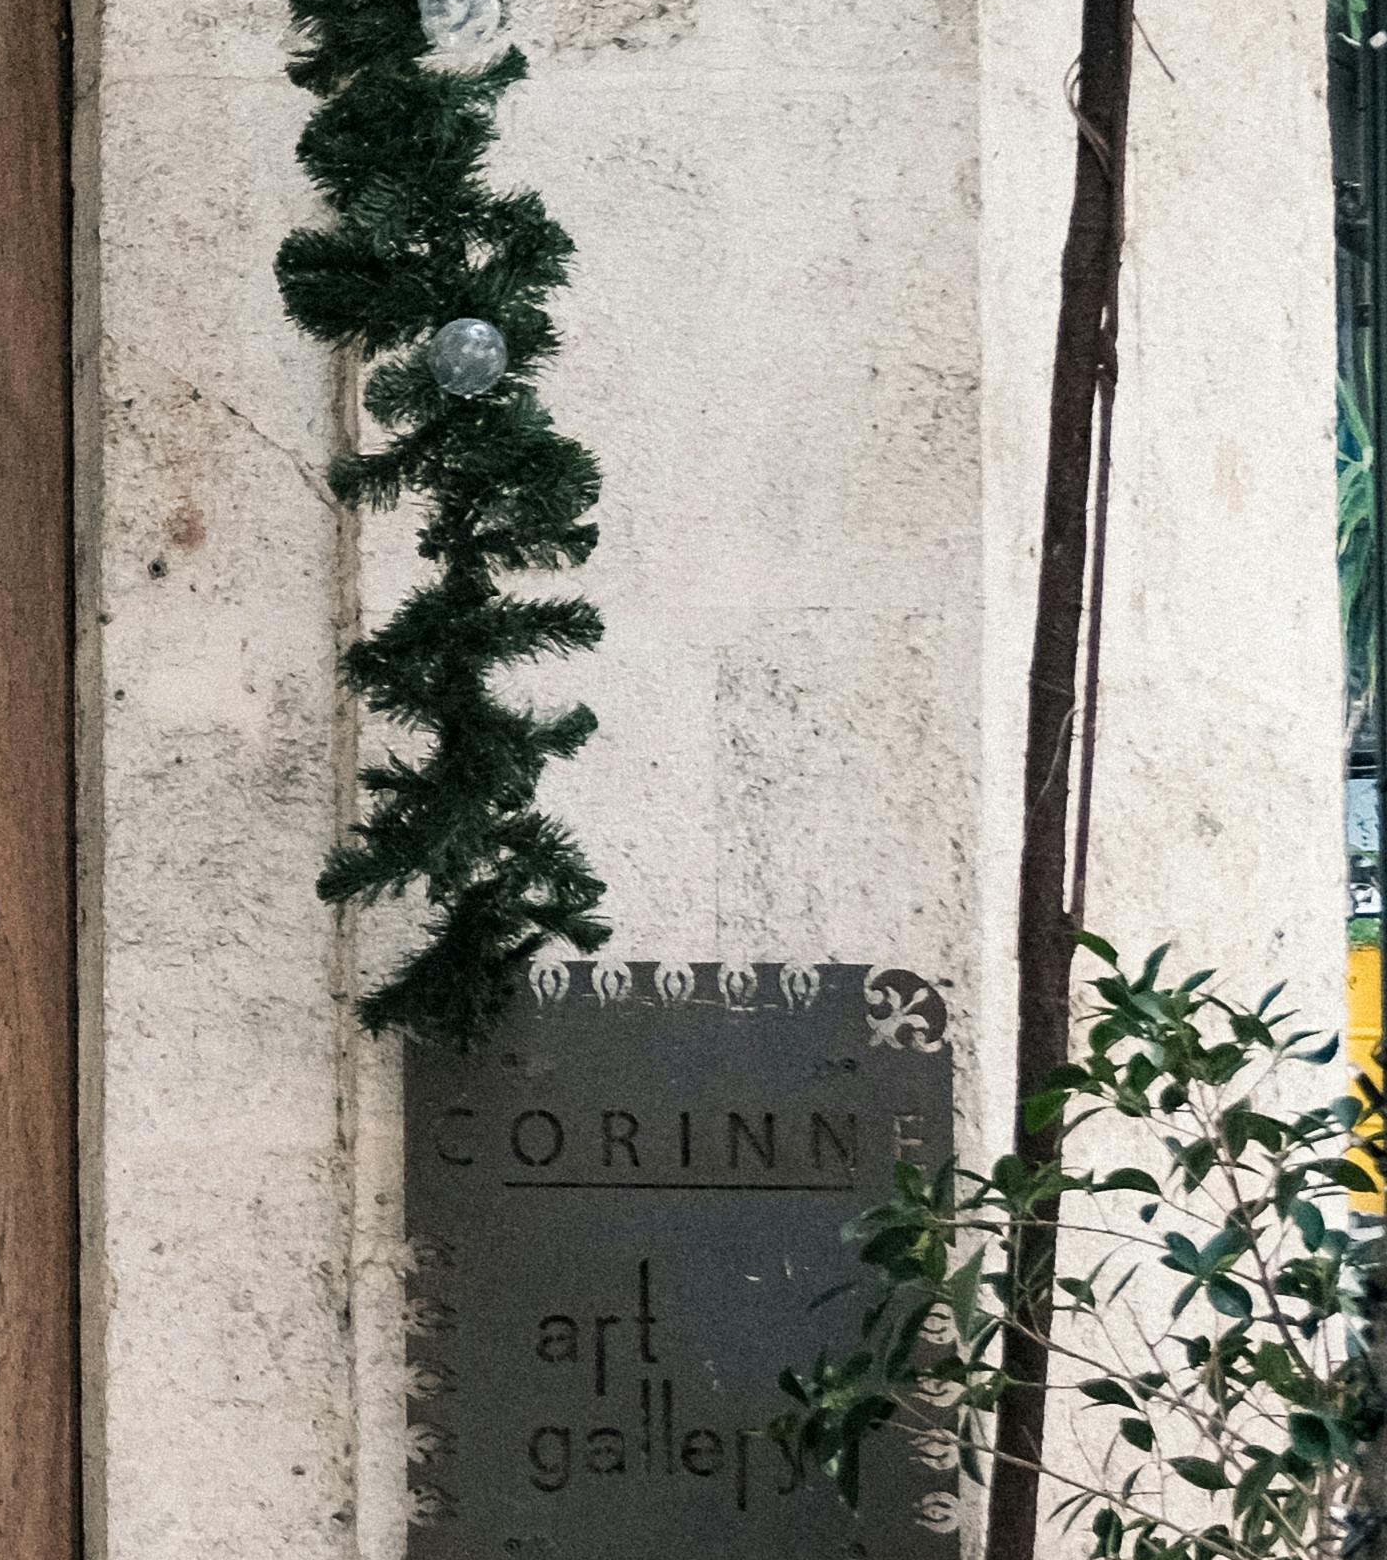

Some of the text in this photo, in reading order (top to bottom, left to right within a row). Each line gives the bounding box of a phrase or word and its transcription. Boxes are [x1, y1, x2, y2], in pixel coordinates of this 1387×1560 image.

[429, 1108, 926, 1172] CORINNE
[534, 1257, 658, 1398] art
[526, 1379, 809, 1512] gallery
